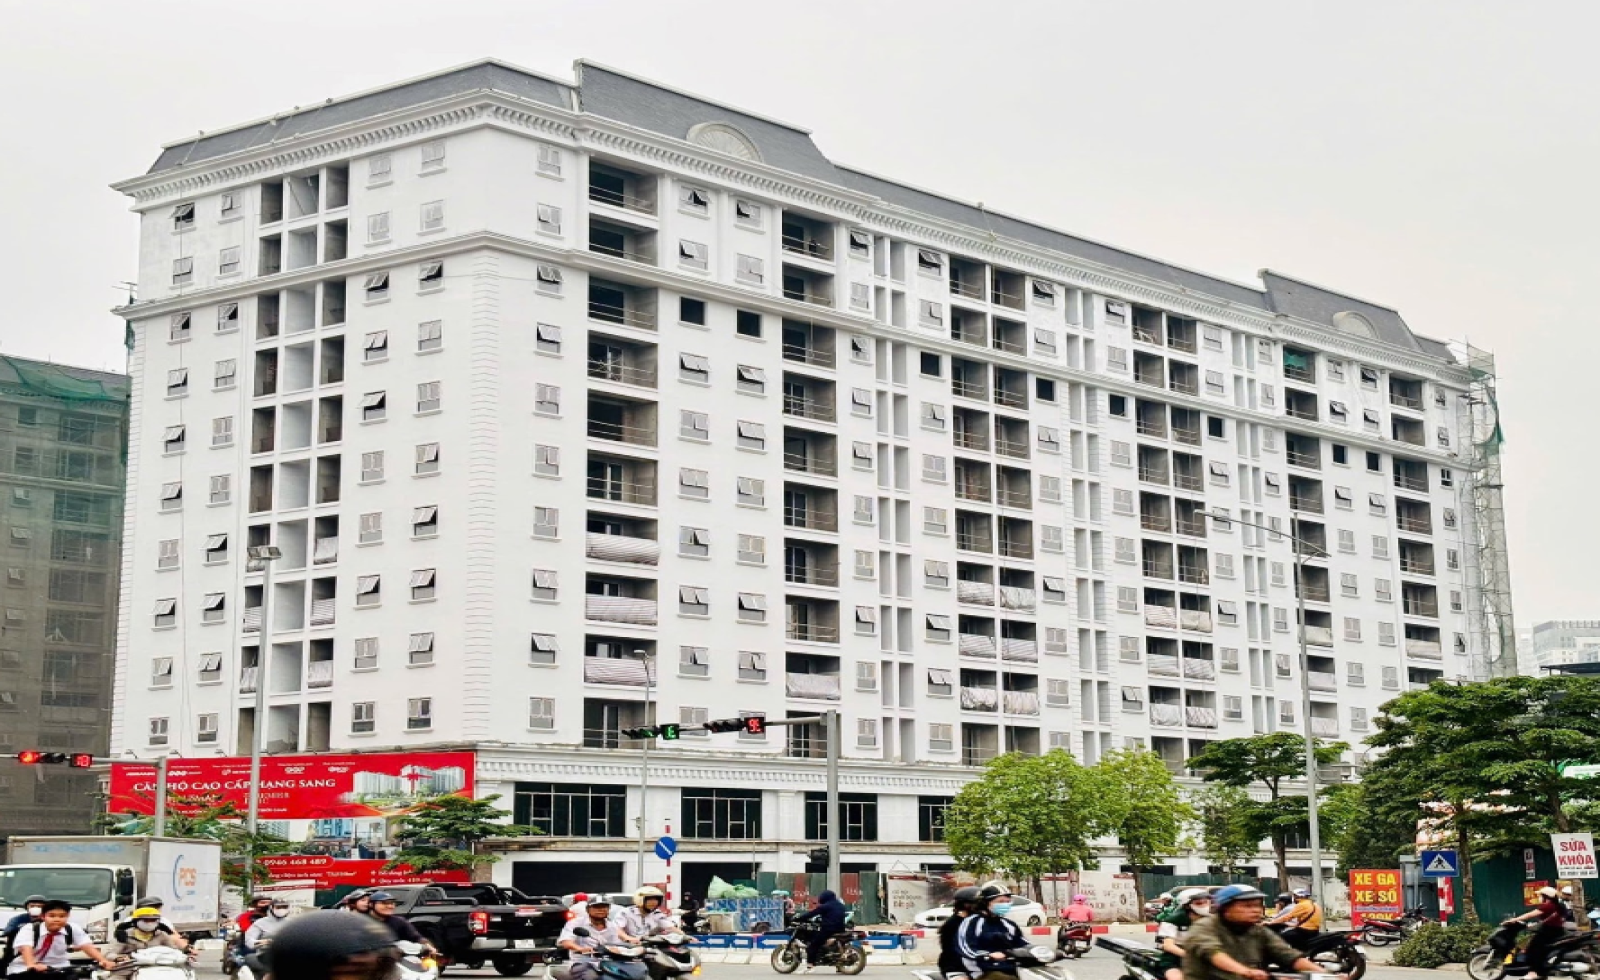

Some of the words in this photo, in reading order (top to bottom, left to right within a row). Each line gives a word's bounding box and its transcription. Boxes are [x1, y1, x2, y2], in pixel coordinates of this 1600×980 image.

[166, 780, 189, 792] HỘ
[192, 782, 221, 790] CAO
[224, 778, 251, 790] CẤP
[299, 778, 336, 788] SANG
[1560, 837, 1588, 852] SỬA
[263, 858, 287, 866] 0946
[1558, 852, 1594, 866] KHÓA
[1354, 872, 1373, 885] XE
[1377, 872, 1397, 886] GA
[1354, 889, 1374, 902] XE
[1378, 886, 1397, 903] SỐ
